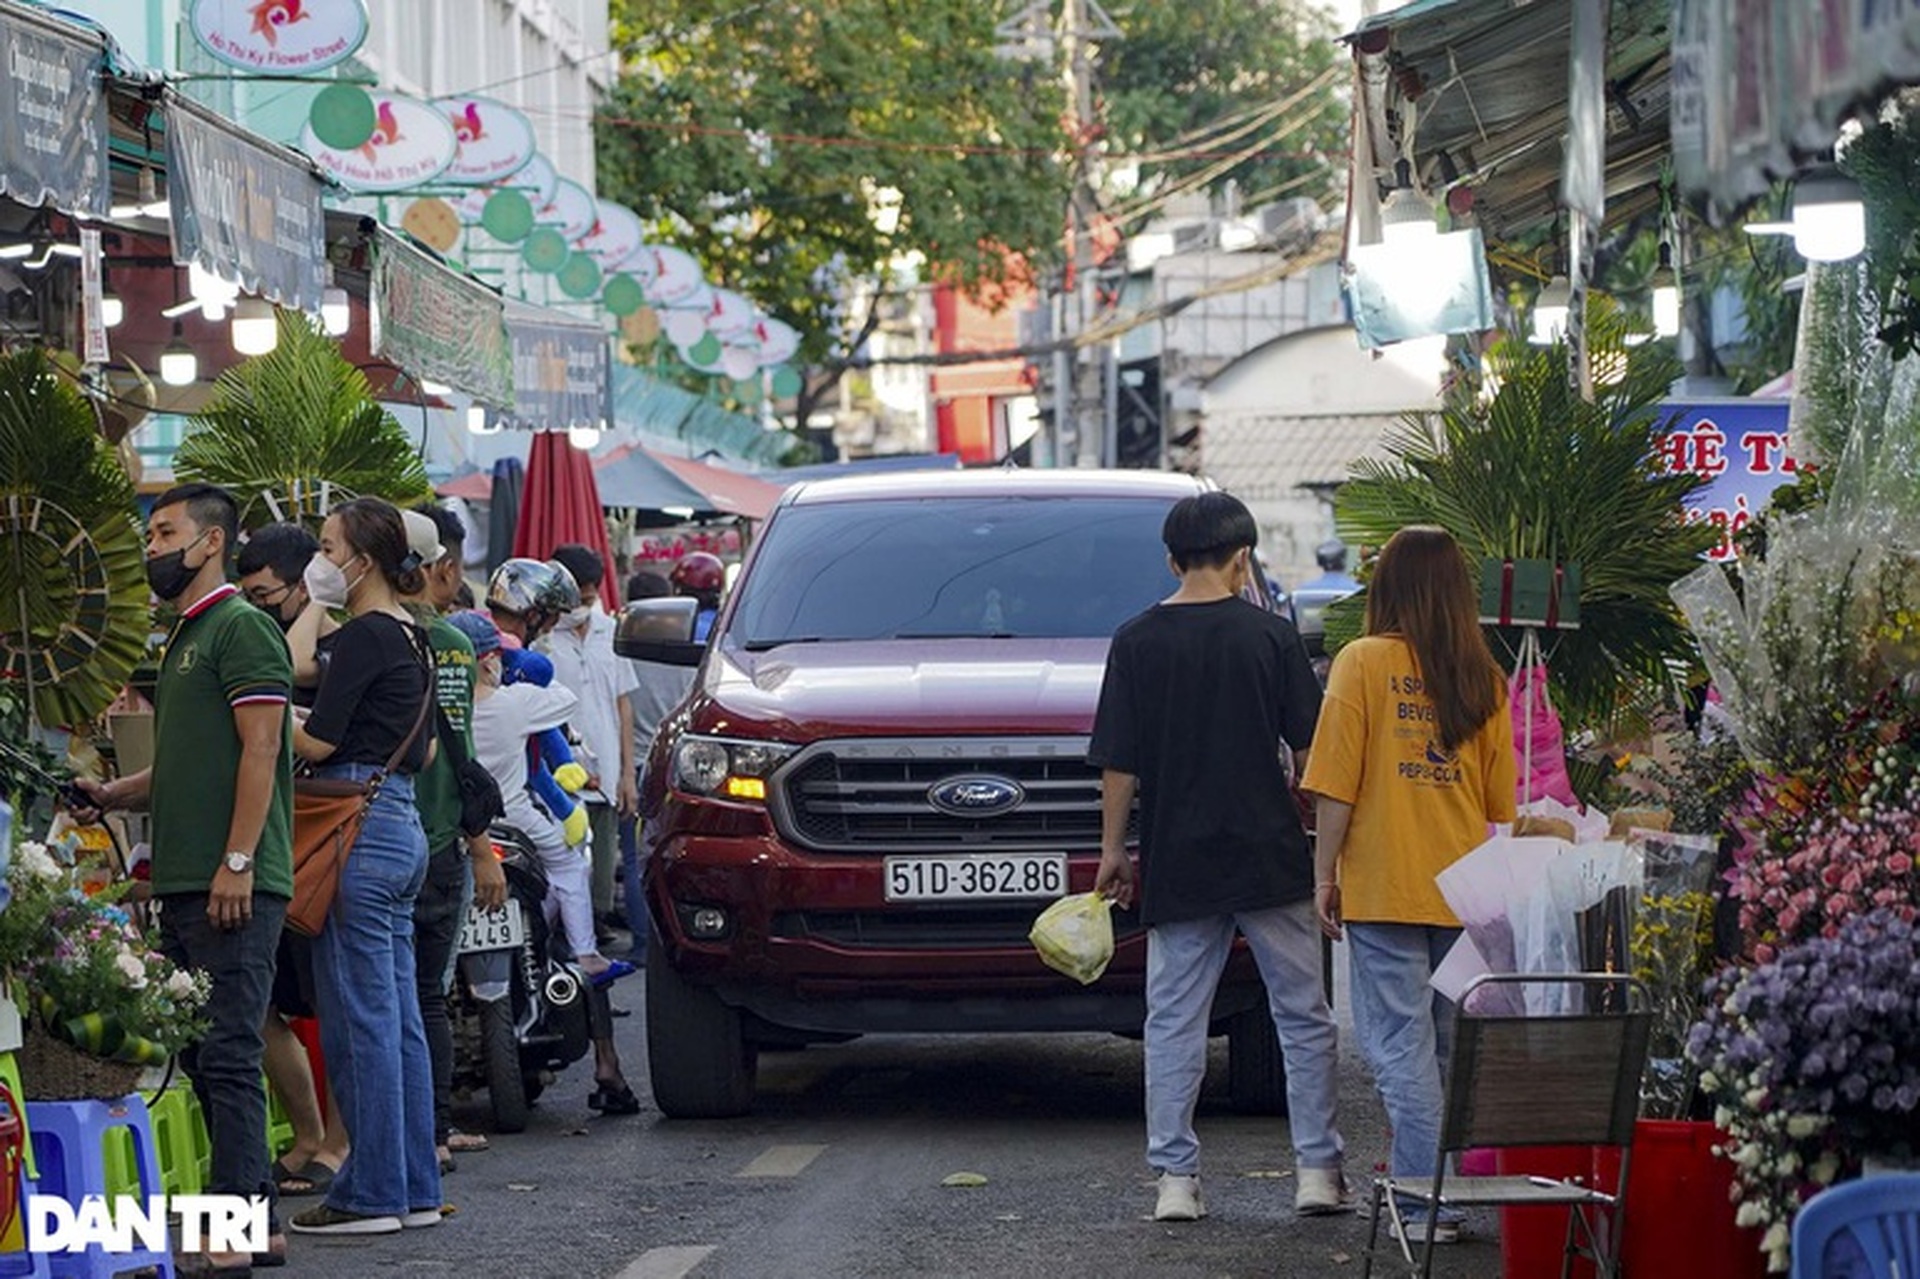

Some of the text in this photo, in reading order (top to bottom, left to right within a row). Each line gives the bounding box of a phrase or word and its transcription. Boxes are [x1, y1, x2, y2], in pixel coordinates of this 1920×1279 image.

[209, 31, 348, 66] Ho Thi Ky Flower Street
[953, 784, 1000, 802] Ford
[892, 860, 1060, 895] 51D-362.86
[460, 925, 512, 949] 2449
